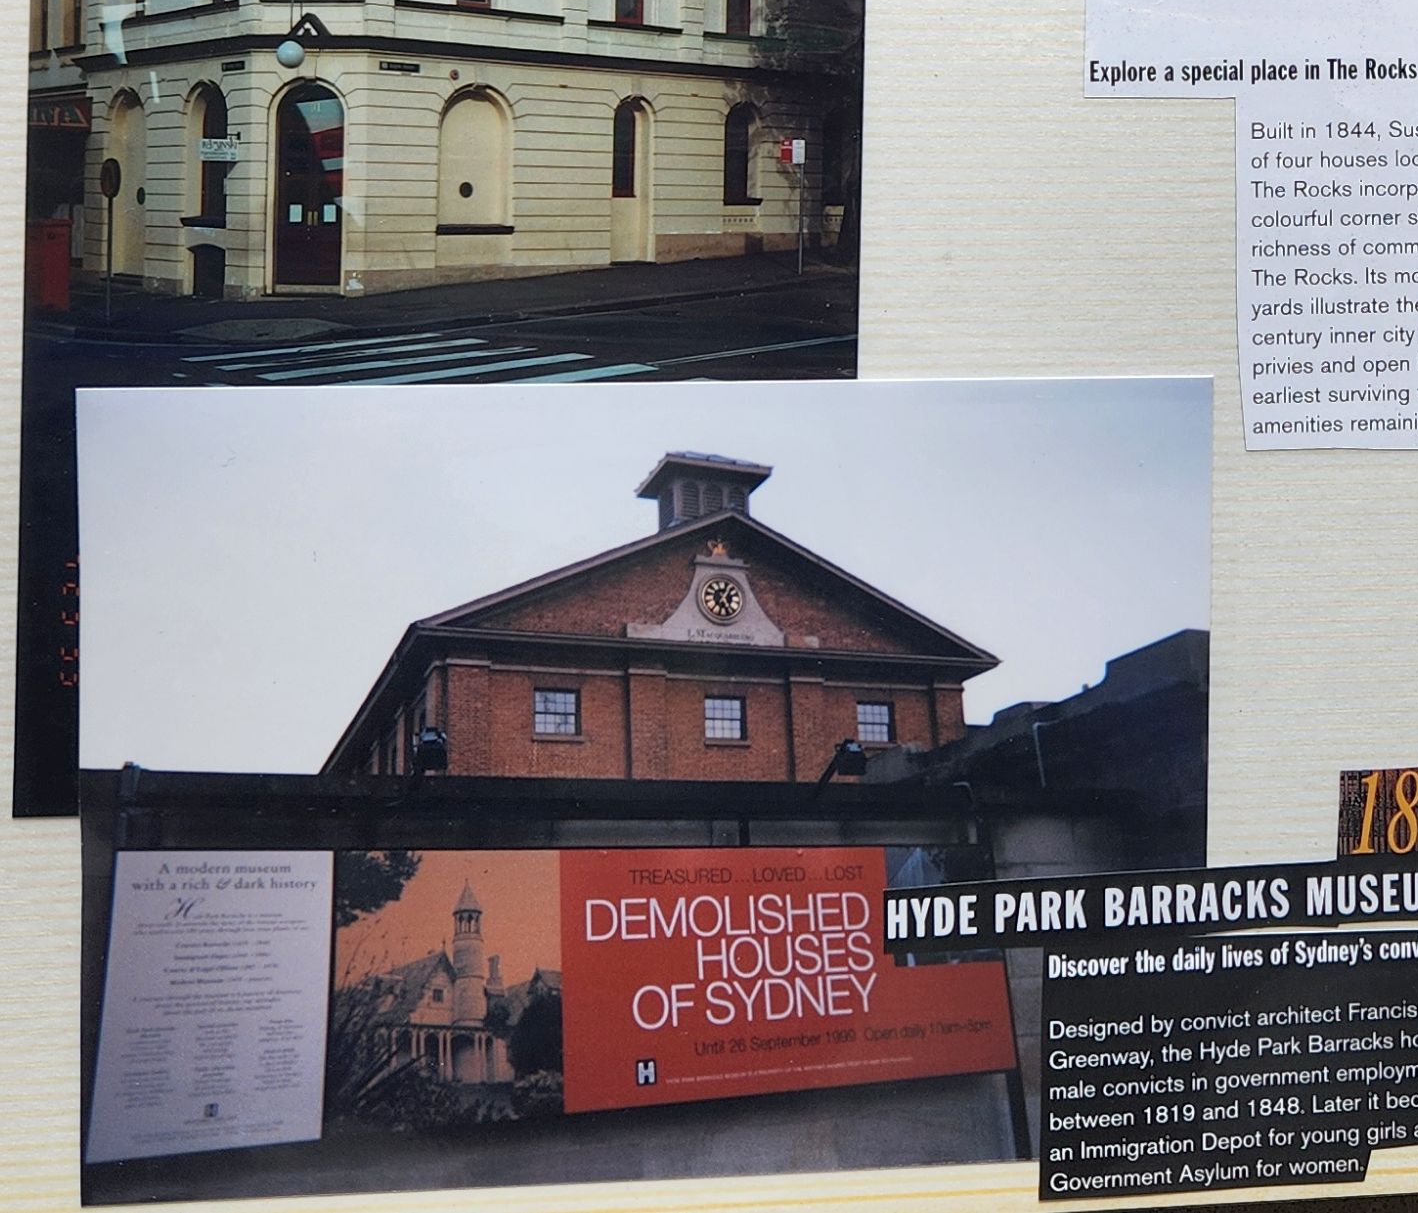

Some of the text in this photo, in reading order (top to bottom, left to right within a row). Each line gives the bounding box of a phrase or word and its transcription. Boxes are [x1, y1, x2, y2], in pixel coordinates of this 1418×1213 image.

[1091, 61, 1156, 86] Explore
[1165, 66, 1173, 81] a
[1182, 60, 1243, 85] special
[1252, 59, 1297, 84] place
[1306, 65, 1319, 79] in
[1327, 59, 1357, 79] The
[1366, 58, 1417, 79] Rocks
[1251, 122, 1293, 139] Built
[1301, 122, 1316, 138] in
[1326, 122, 1380, 141] 1844,
[1251, 152, 1269, 169] of
[1276, 152, 1313, 169] four
[1321, 151, 1388, 168] houses
[132, 877, 317, 892] with a rich & dark history
[159, 862, 291, 874] A modern museum
[585, 892, 870, 941] DEMOLISHED
[888, 896, 977, 939] HYDE
[996, 890, 1086, 932] PARK
[1105, 879, 1289, 926] BARRACKS
[697, 932, 875, 980] HOUSES
[1049, 955, 1128, 978] Discover
[1135, 950, 1165, 973] the
[1173, 947, 1215, 973] daily
[1222, 945, 1263, 967] lives
[1271, 942, 1289, 964] of
[1295, 938, 1372, 967] Sydney's
[632, 973, 877, 1030] OF SYDNEY
[1050, 1000, 1417, 1041] Designed by convict architect Francis
[730, 1039, 746, 1053] 26
[750, 1033, 821, 1052] September
[1049, 1050, 1154, 1069] Greenway,
[1161, 1044, 1192, 1062] the
[1200, 1039, 1251, 1064] Hyde
[1258, 1036, 1301, 1056] Park
[1309, 1032, 1394, 1053] Barracks
